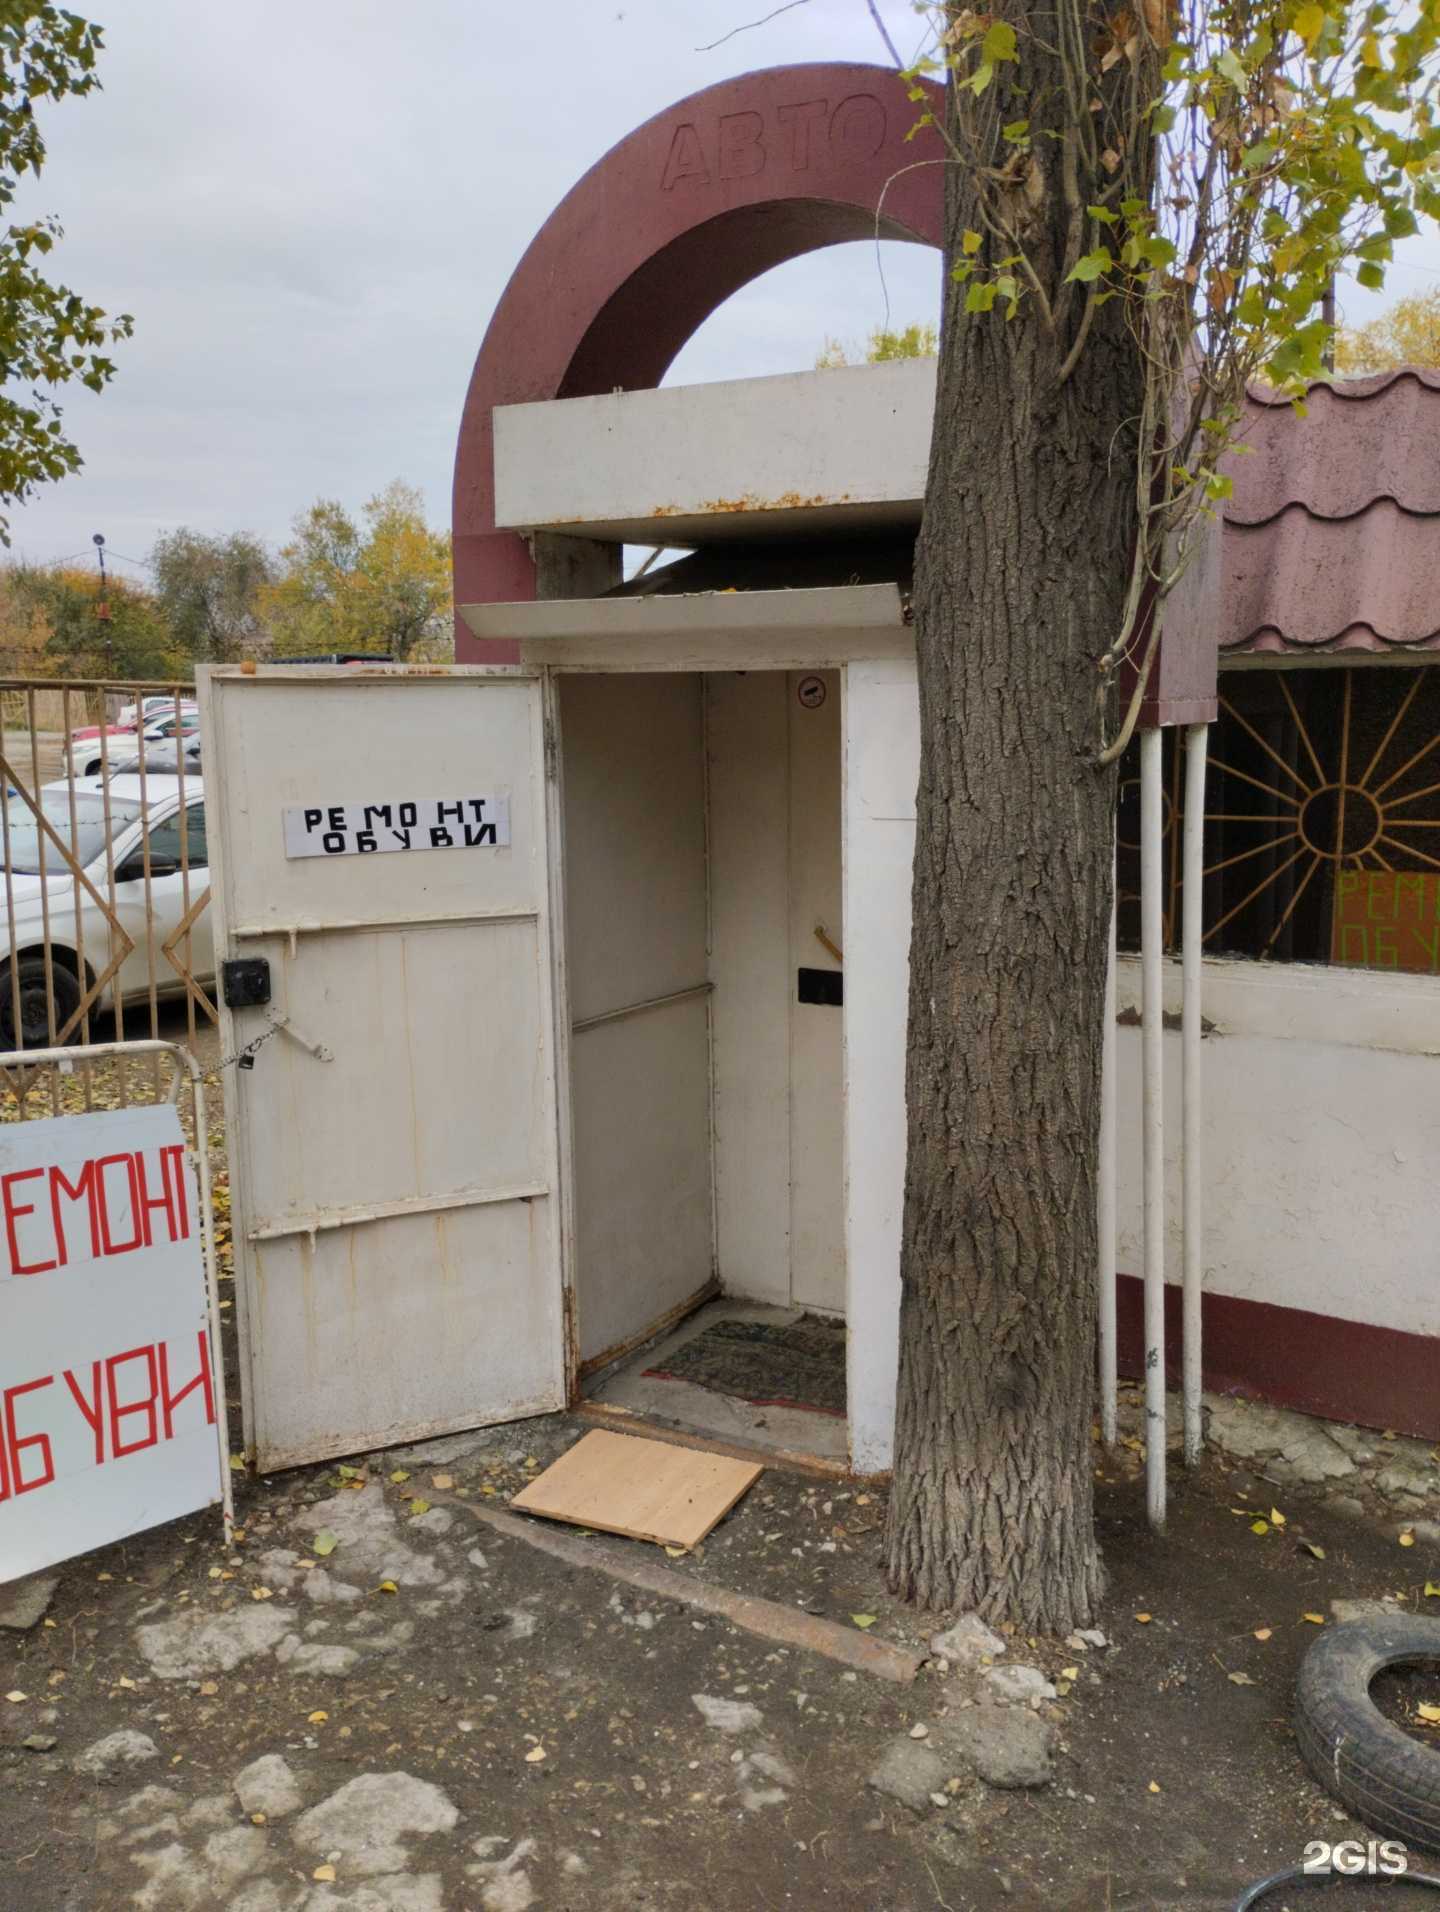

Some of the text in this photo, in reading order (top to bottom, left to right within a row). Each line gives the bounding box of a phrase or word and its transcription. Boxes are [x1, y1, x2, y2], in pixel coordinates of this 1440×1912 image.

[660, 92, 888, 191] АВТО
[304, 799, 486, 833] РЕМОНТ
[322, 823, 497, 853] ОБУВИ
[0, 1330, 216, 1502] БУВИ
